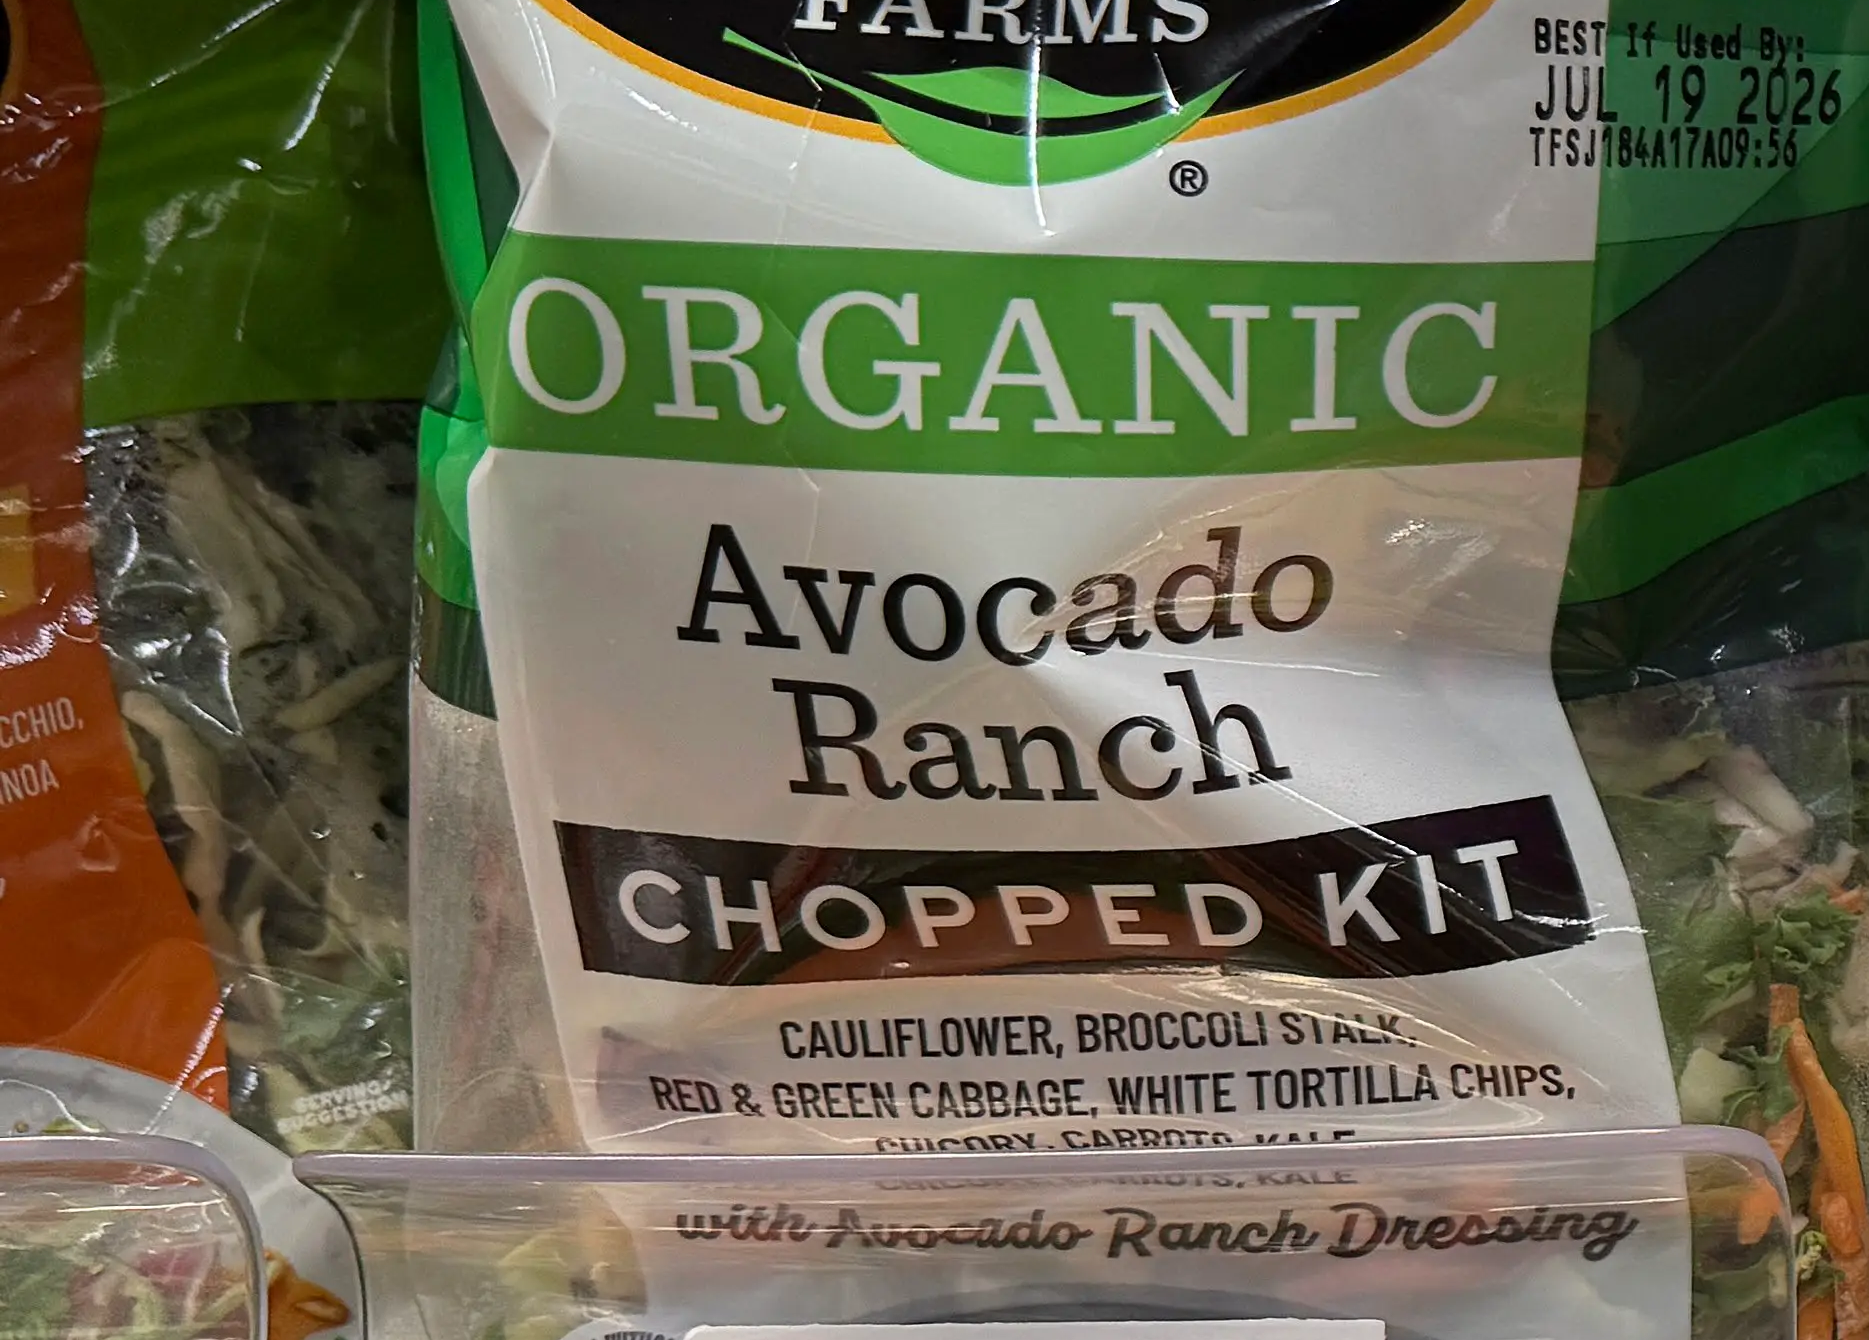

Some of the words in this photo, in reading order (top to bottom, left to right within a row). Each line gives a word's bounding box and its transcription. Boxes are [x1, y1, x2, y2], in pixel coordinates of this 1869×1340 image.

[1534, 17, 1606, 56] BEST
[1627, 22, 1658, 58] If
[1675, 22, 1742, 61] Used
[1760, 24, 1806, 72] By:
[1534, 64, 1619, 123] JUL
[1655, 66, 1704, 123] 19
[1736, 64, 1842, 126] 2026
[506, 276, 1499, 438] ORGANIC
[676, 526, 1334, 666] Avocado
[772, 671, 1293, 803] Ranch
[617, 866, 1263, 954] CHOPPED
[1317, 838, 1521, 950] KIT
[778, 1014, 1066, 1061] CAULIFLOWER,
[1075, 1011, 1268, 1055] BROCCOLI
[649, 1074, 723, 1116] RED
[733, 1078, 765, 1116] &
[773, 1078, 899, 1119] GREEN
[908, 1078, 1099, 1121] CABBAGE,
[1110, 1070, 1236, 1114] WHITE
[1246, 1062, 1439, 1111] TORTILLA
[1448, 1061, 1577, 1104] CHIPS,
